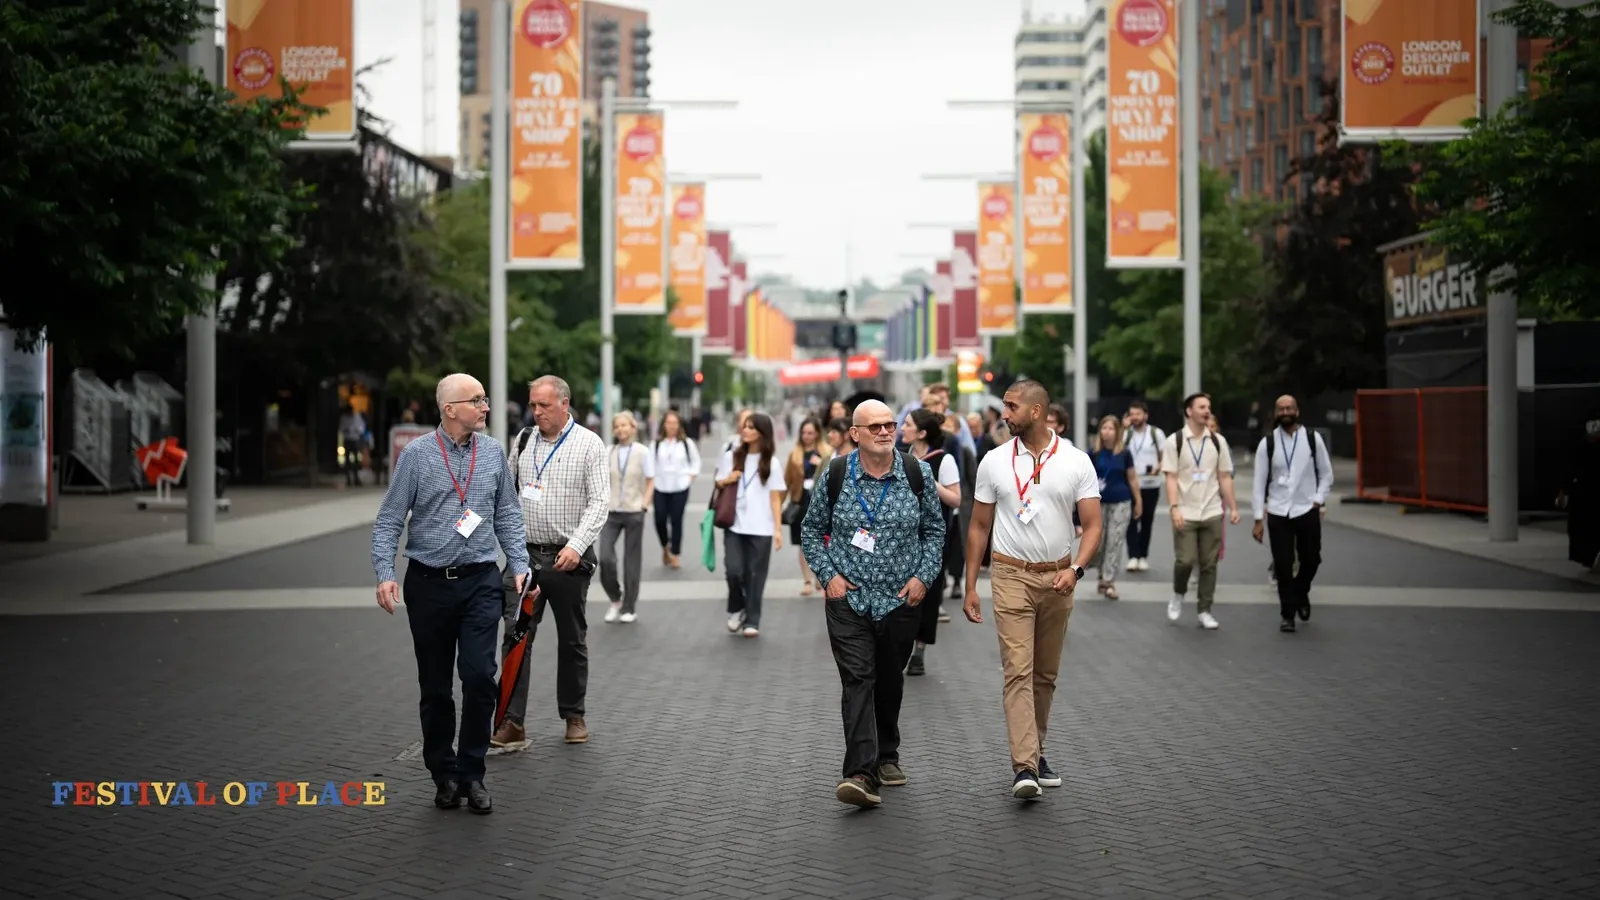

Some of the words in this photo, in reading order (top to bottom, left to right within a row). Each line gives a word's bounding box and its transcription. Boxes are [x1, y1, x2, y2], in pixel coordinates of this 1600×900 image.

[281, 46, 338, 58] LONDON
[1402, 40, 1462, 52] LONDON
[281, 57, 346, 70] DESIGNER
[1402, 51, 1470, 64] DESIGNER
[281, 67, 328, 81] OUTLET
[1402, 63, 1453, 76] OUTLET
[530, 72, 563, 97] 70
[1126, 70, 1160, 94] 70
[1112, 109, 1153, 125] DINE
[521, 127, 570, 144] SHOP
[1119, 125, 1168, 142] SHOP
[1392, 261, 1478, 318] BURGER
